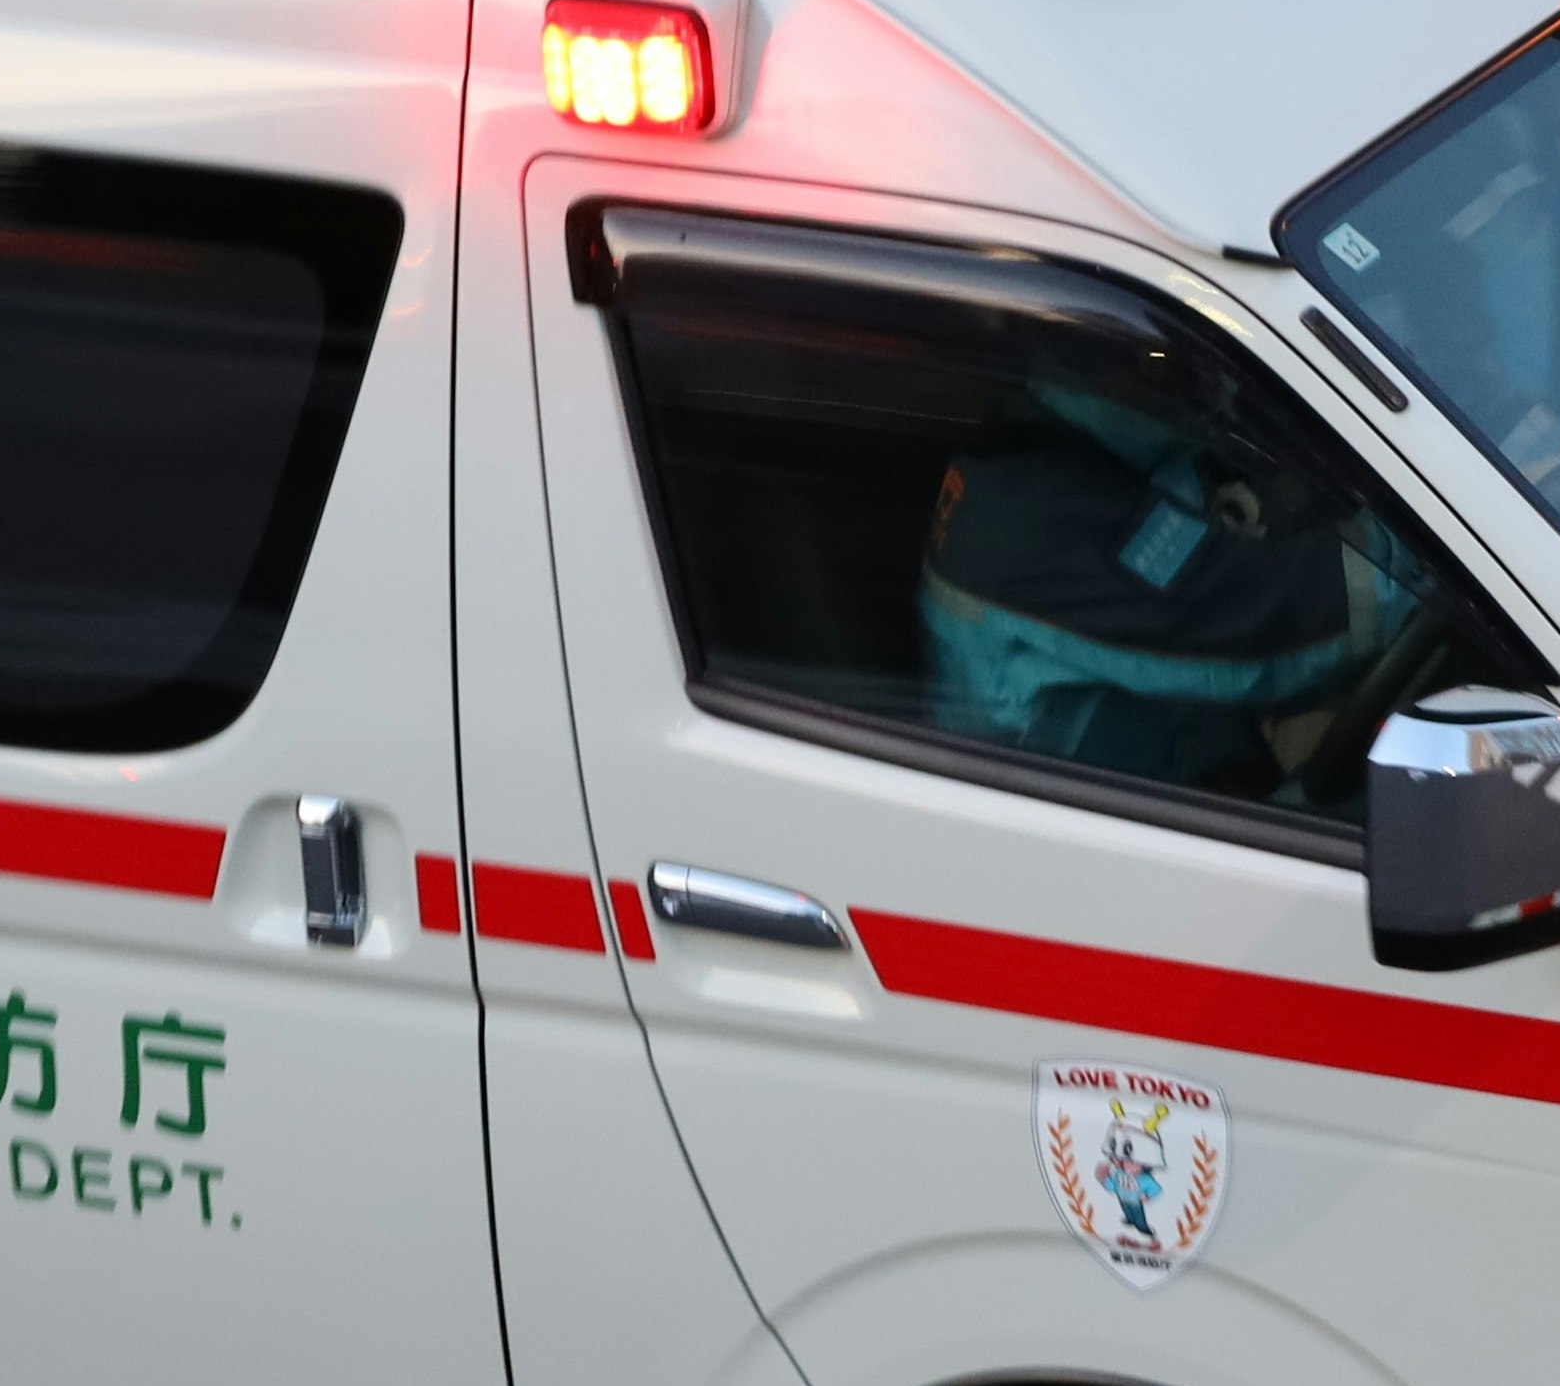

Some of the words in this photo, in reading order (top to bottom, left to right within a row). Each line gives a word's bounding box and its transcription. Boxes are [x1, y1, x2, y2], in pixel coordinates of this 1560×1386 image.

[1053, 1068, 1118, 1091] LOVE
[1124, 1073, 1210, 1109] TOKYO
[8, 1137, 243, 1230] DEPT.
